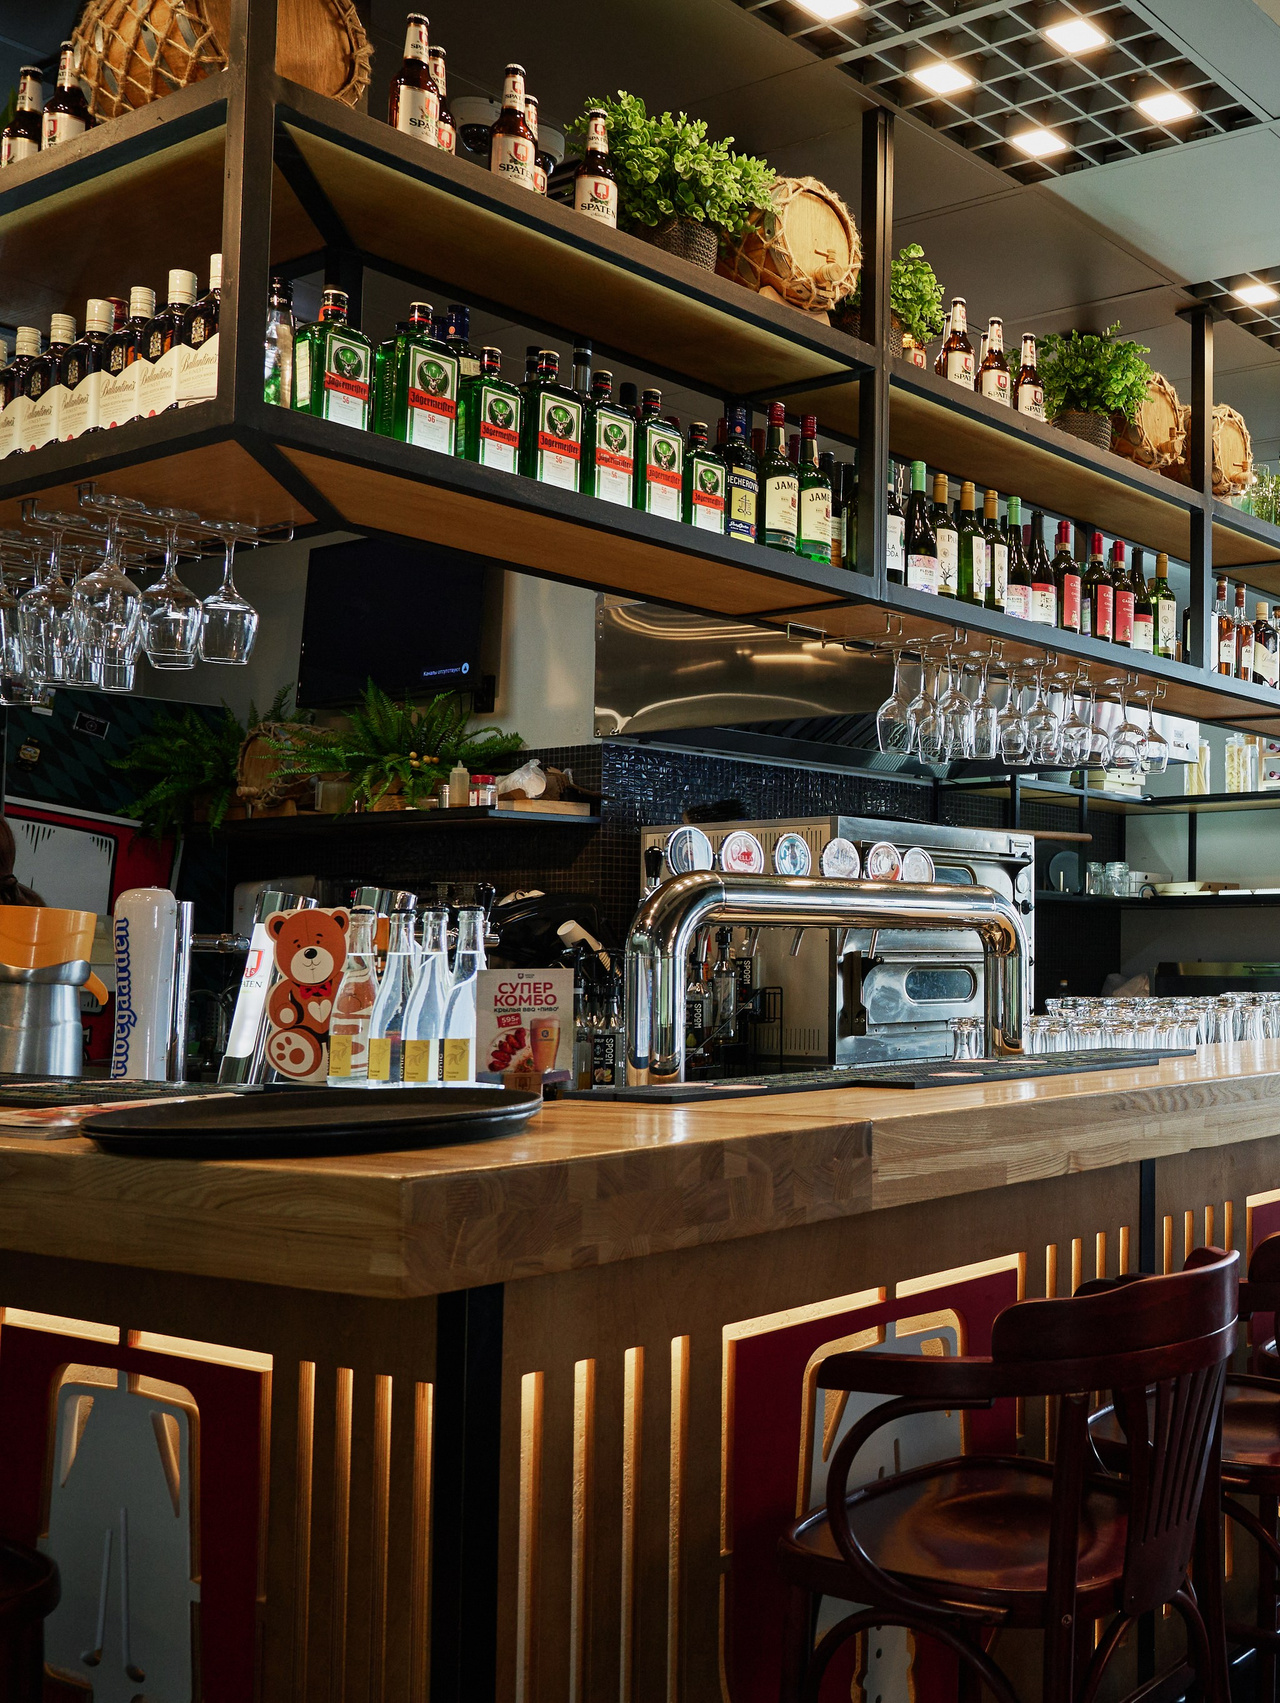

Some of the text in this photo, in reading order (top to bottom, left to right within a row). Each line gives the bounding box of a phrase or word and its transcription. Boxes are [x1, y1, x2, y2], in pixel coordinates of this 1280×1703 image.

[580, 203, 616, 219] SPATEN
[326, 374, 368, 397] Jägermeister
[410, 390, 455, 414] Jägermeister
[482, 424, 518, 443] Jägermeister
[540, 435, 579, 455] Jägermeister
[498, 982, 554, 995] СУПЕР
[494, 994, 558, 1007] КОМБО
[605, 1037, 614, 1065] SPOOM
